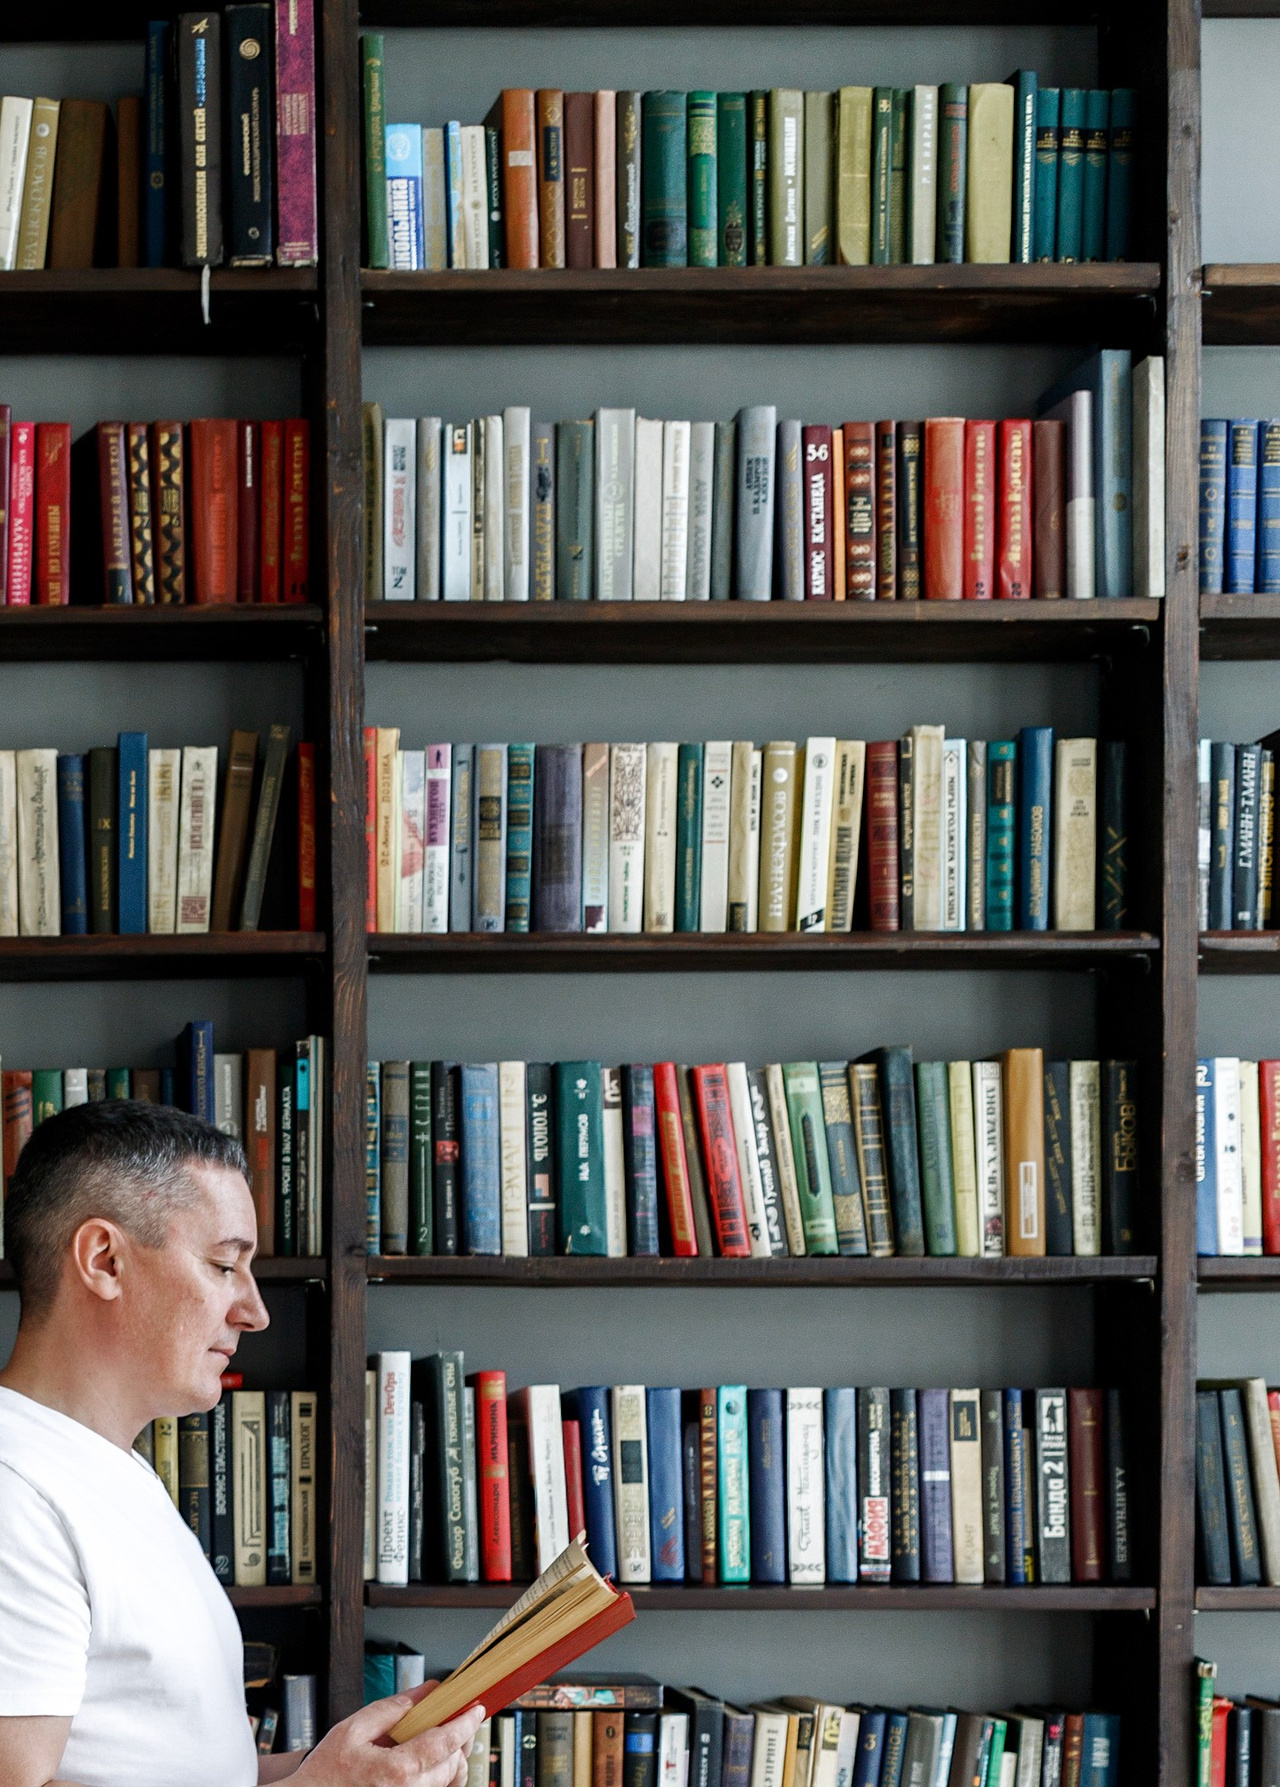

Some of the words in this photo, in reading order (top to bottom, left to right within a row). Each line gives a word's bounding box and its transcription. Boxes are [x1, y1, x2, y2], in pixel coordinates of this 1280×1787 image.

[193, 108, 207, 142] ДЕТЕЙ
[195, 170, 207, 258] ЭНЦИКЛОПЕДИЯ
[811, 472, 826, 544] КАСТАНЕДА
[811, 550, 826, 595] КАРЛОС
[1031, 805, 1045, 856] НАБОКОВ
[533, 1112, 549, 1162] ТОПОЛЬ
[578, 1114, 589, 1158] ПЕРУМОВ
[384, 1371, 397, 1416] DevOps
[299, 1423, 311, 1471] ПРОЛОГ
[1043, 1461, 1064, 1474] 2
[215, 1474, 226, 1515] БОРИС
[447, 1466, 464, 1522] Сологуб
[1043, 1477, 1066, 1539] Банда
[381, 1511, 395, 1564] Проект
[450, 1525, 466, 1569] Федор
[866, 1499, 886, 1557] МАФИЯ
